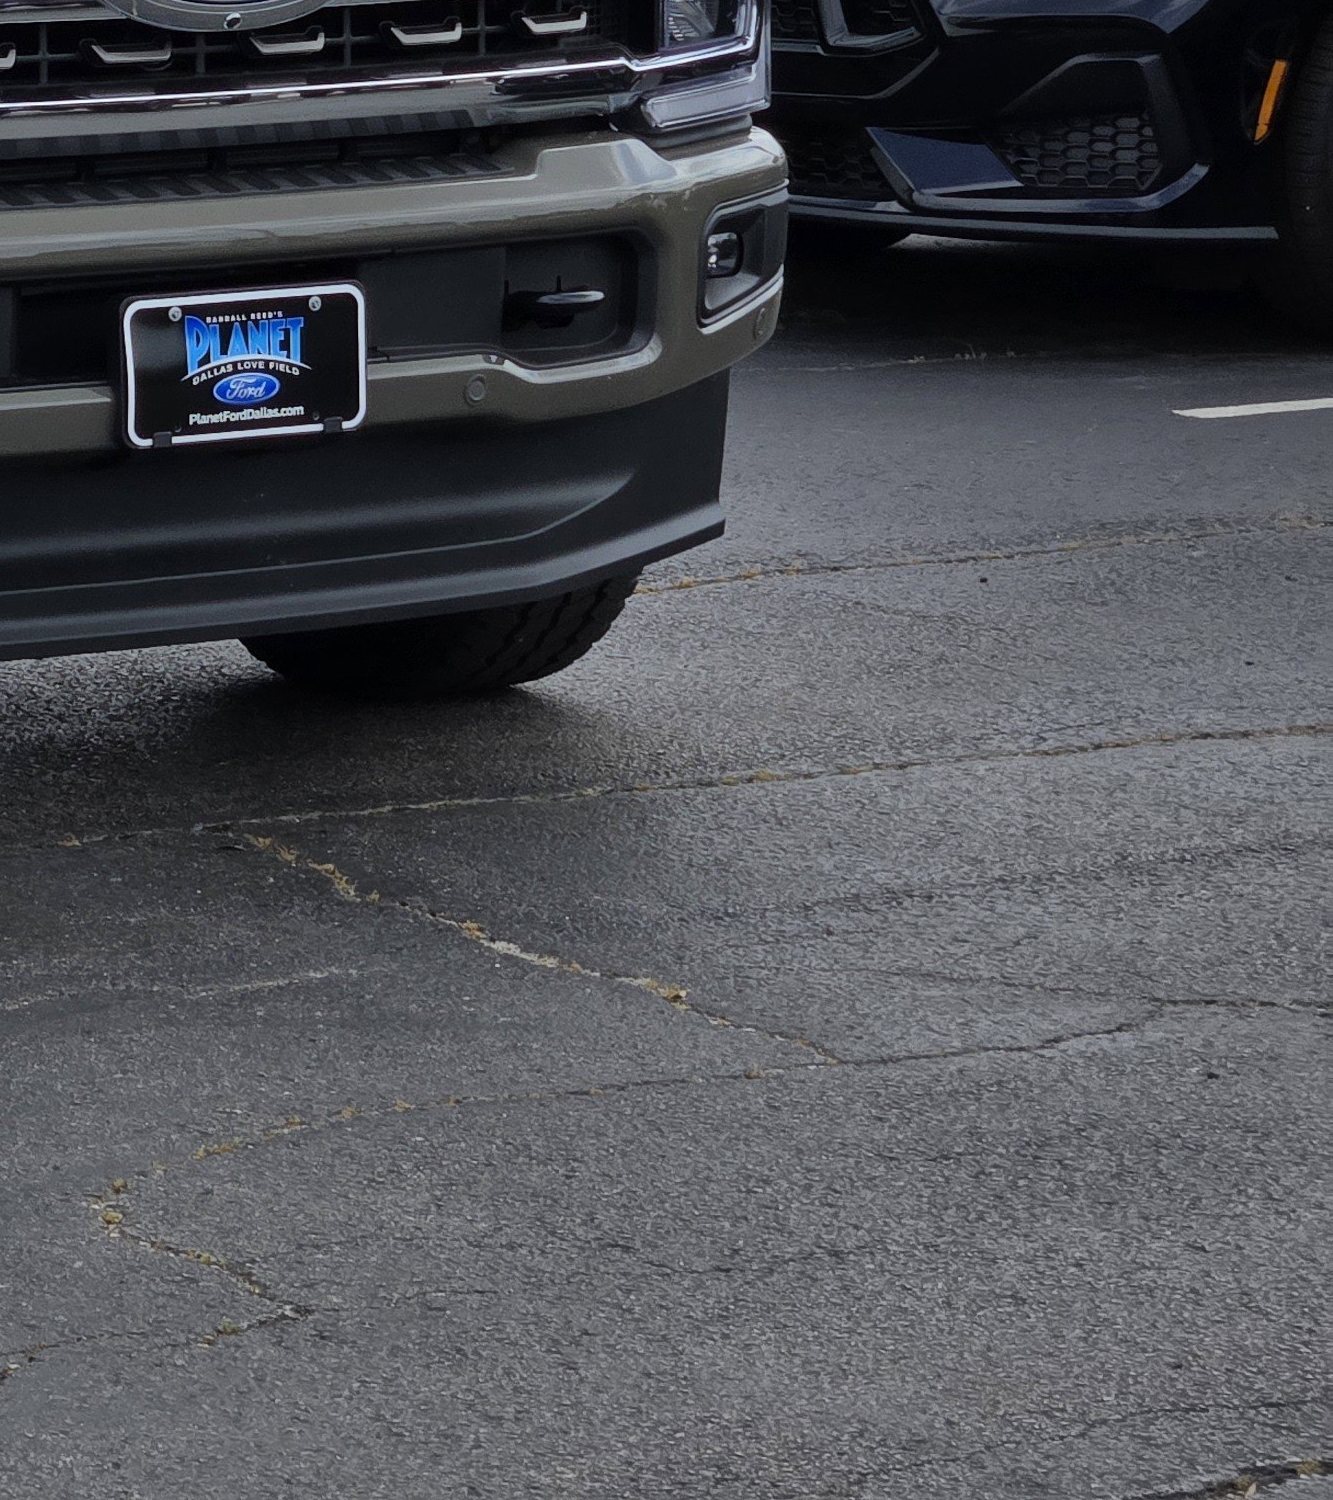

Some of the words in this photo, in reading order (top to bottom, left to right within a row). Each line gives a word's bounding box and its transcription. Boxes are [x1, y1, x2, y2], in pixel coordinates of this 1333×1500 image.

[185, 316, 304, 376] PLANET
[192, 364, 233, 386] DALLAS
[237, 361, 265, 371] LOVE
[269, 362, 300, 376] FIELD
[226, 378, 267, 400] Ford
[189, 405, 305, 425] PlanetFordDallas.com
